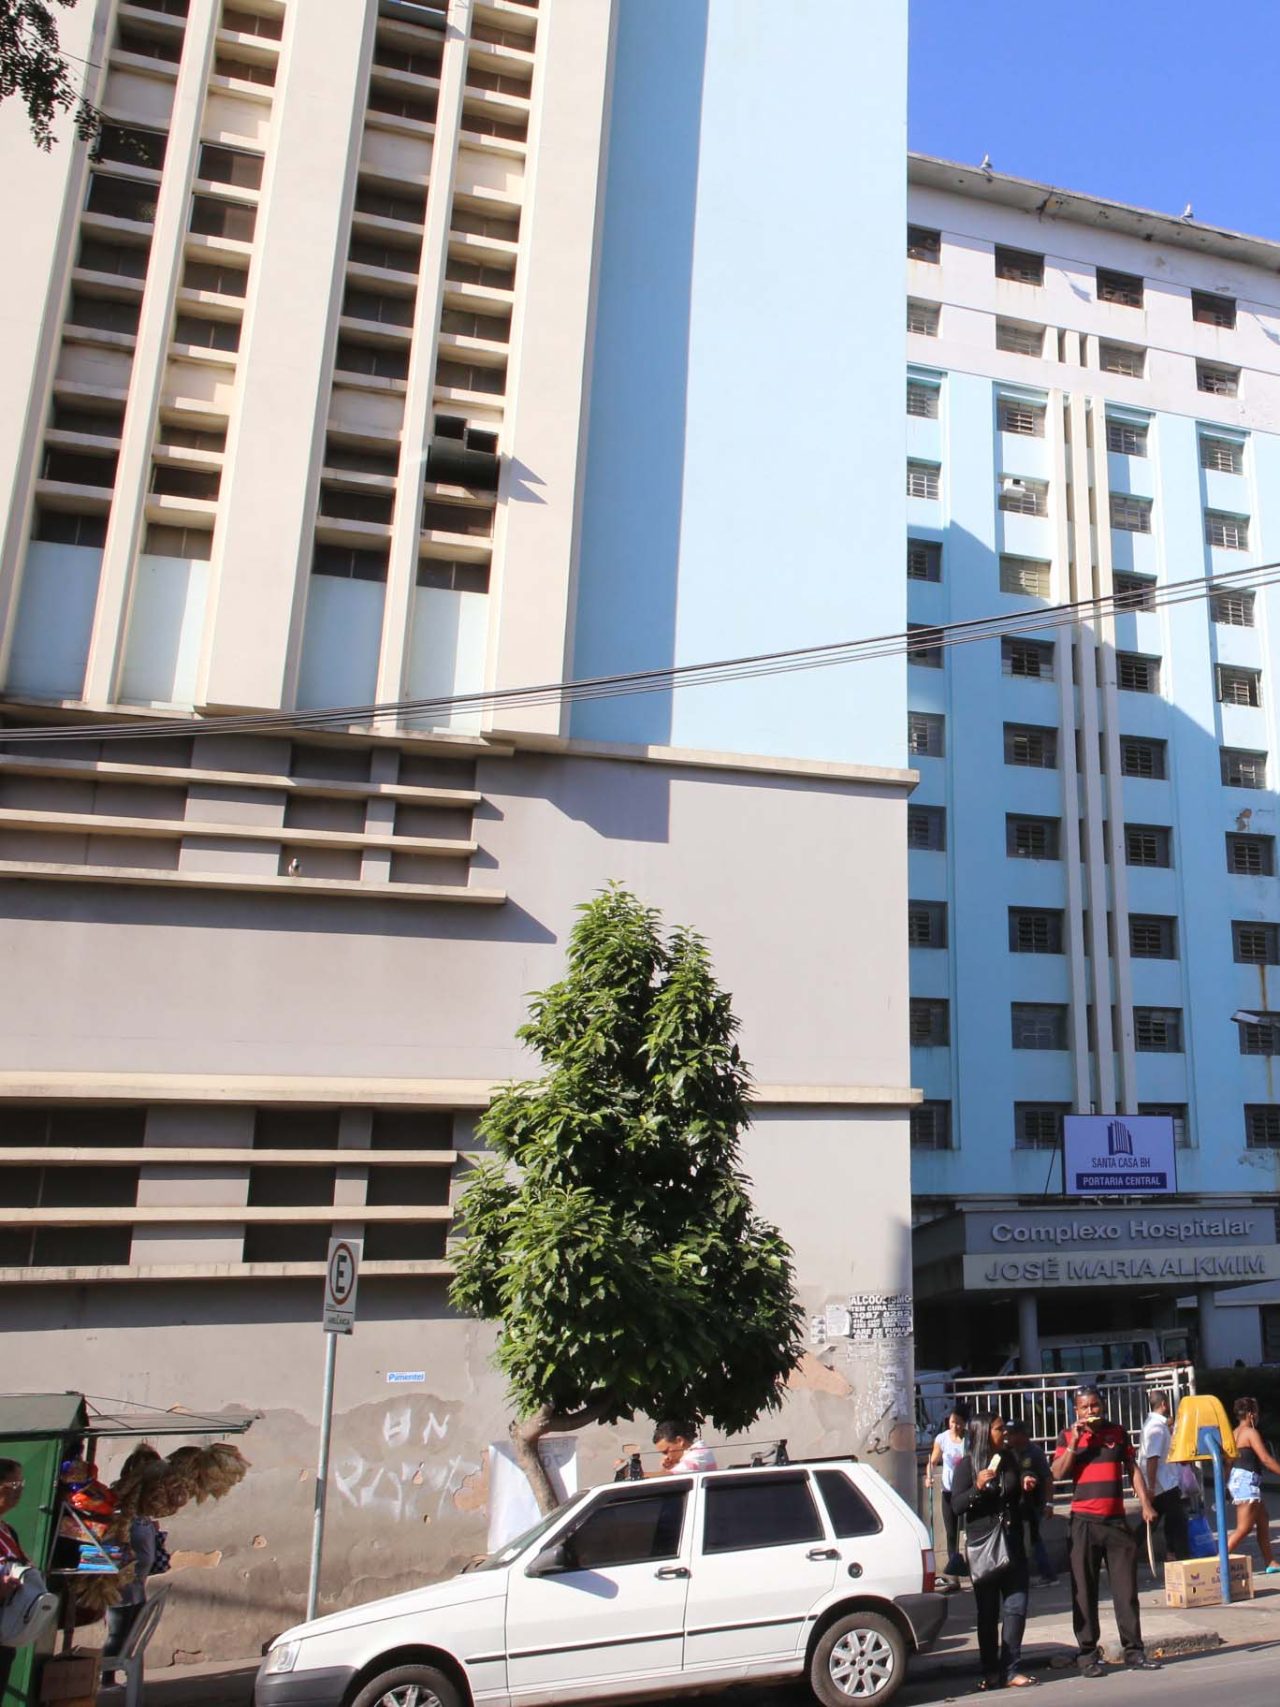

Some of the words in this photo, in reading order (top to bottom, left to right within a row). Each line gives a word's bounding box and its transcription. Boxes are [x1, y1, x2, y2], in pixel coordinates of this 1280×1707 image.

[1091, 1157, 1117, 1168] SANTA
[1118, 1157, 1138, 1168] CASA
[1140, 1157, 1151, 1168] BH
[1082, 1176, 1124, 1186] PORTARIA
[1125, 1176, 1161, 1185] CENTRAL
[991, 1221, 1121, 1244] Complexo
[1129, 1219, 1254, 1242] Hospitalar
[335, 1254, 348, 1294] E
[985, 1257, 1059, 1282] JOSÉ
[1067, 1256, 1156, 1281] MARIA
[1160, 1254, 1265, 1278] ALKMIM
